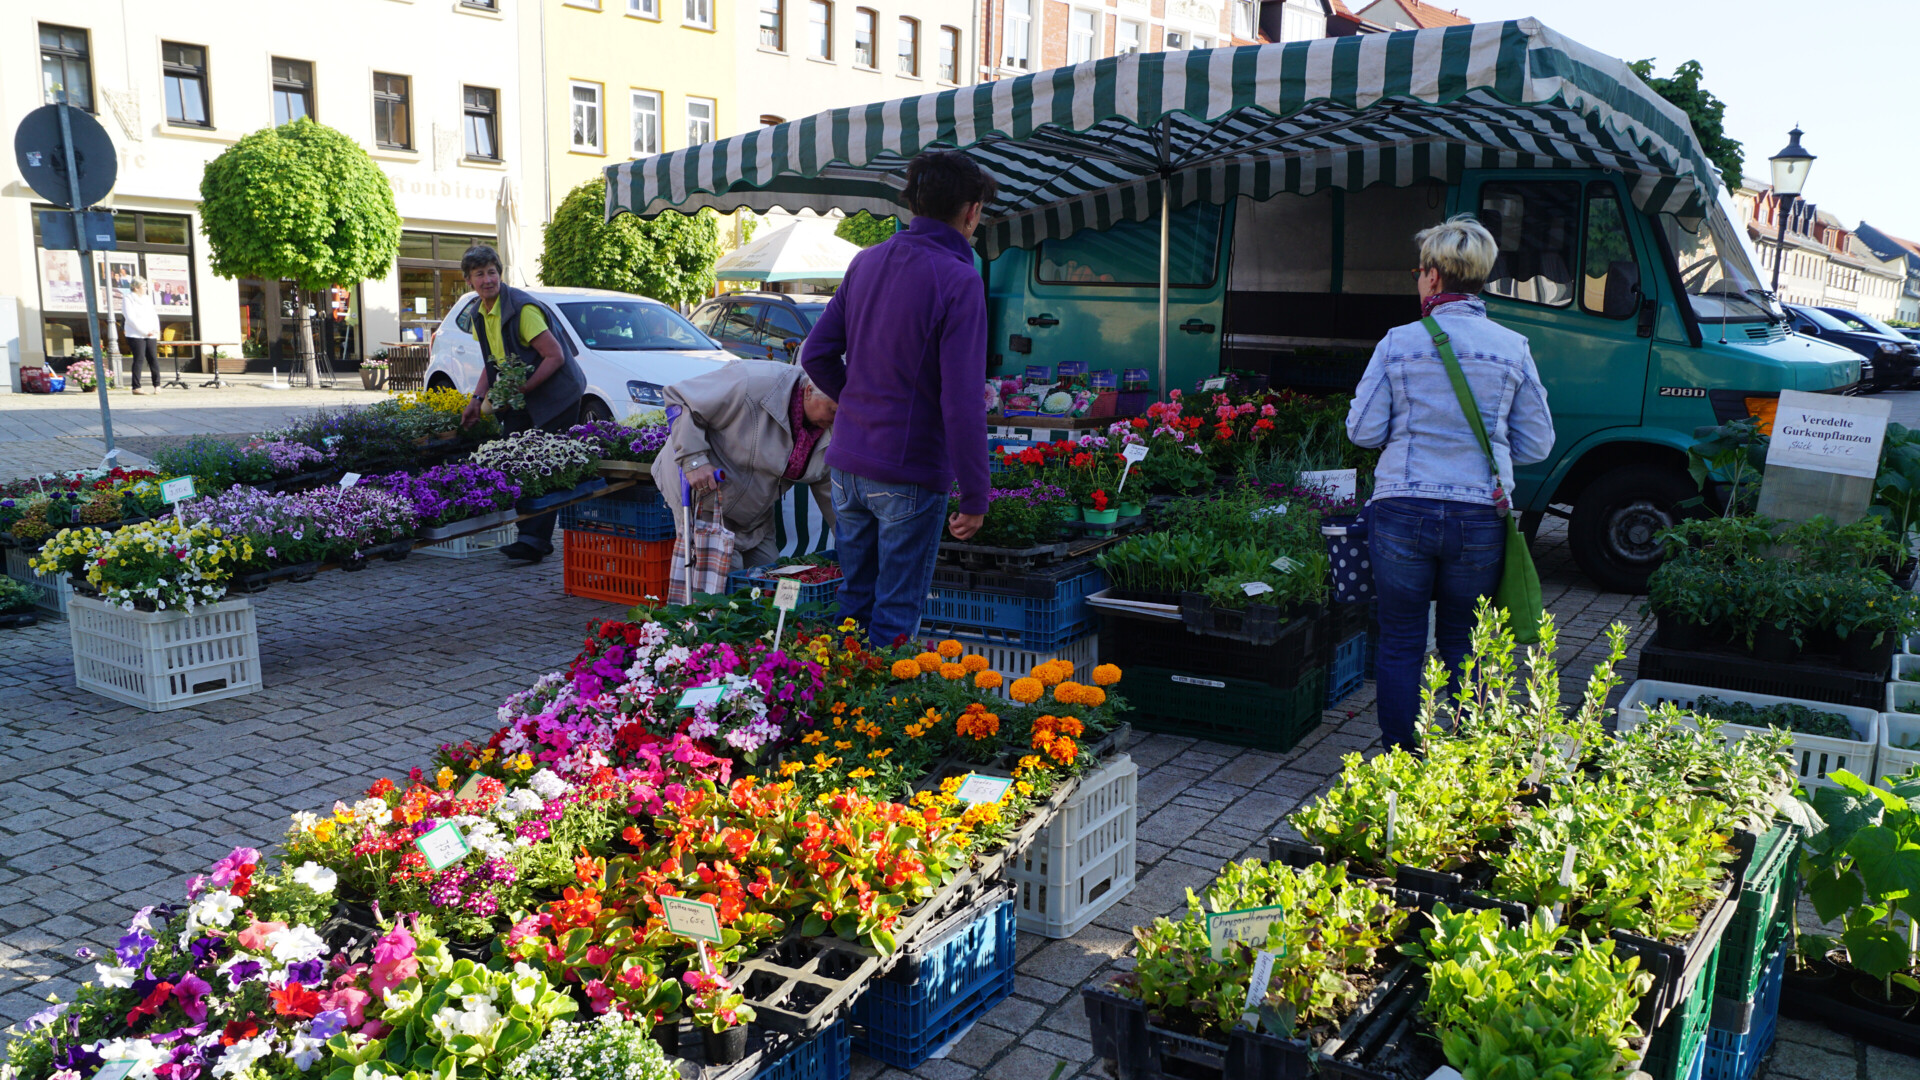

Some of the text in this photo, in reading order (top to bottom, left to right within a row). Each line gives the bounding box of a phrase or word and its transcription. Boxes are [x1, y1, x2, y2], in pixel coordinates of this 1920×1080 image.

[389, 174, 520, 201] Konditori
[1660, 387, 1706, 397] 208D
[1802, 414, 1854, 428] Veredelte
[1782, 425, 1872, 444] Gurkenpflanzen
